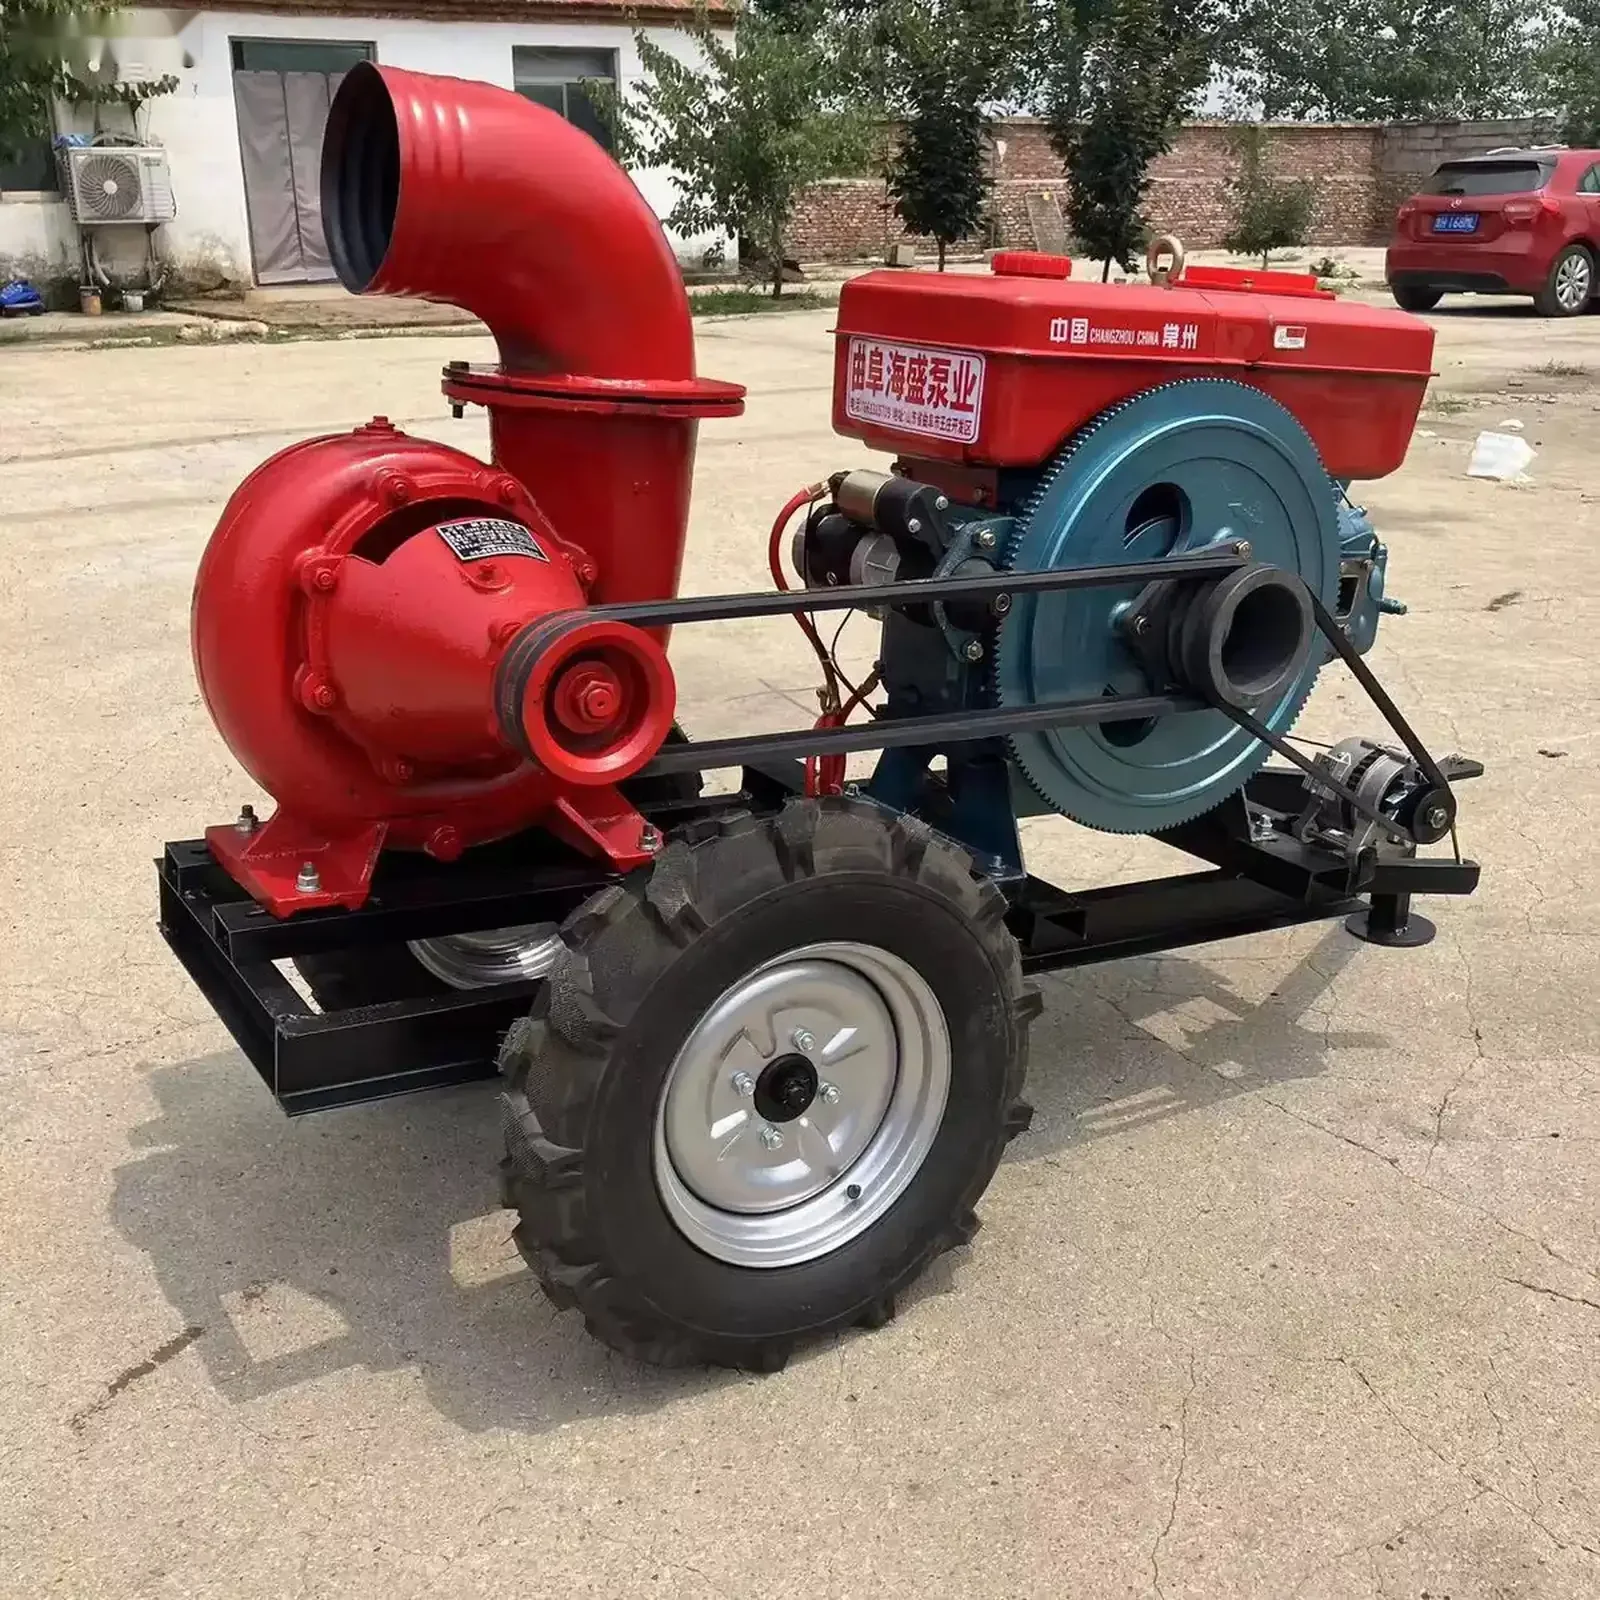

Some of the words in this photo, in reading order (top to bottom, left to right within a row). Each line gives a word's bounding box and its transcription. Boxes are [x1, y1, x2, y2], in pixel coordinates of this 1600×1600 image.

[1050, 317, 1088, 344] 中国
[1090, 328, 1135, 344] CHANGZHOU
[1136, 330, 1159, 346] CHINA
[1162, 323, 1198, 349] 常州
[852, 343, 977, 412] 曲阜海盛泵业
